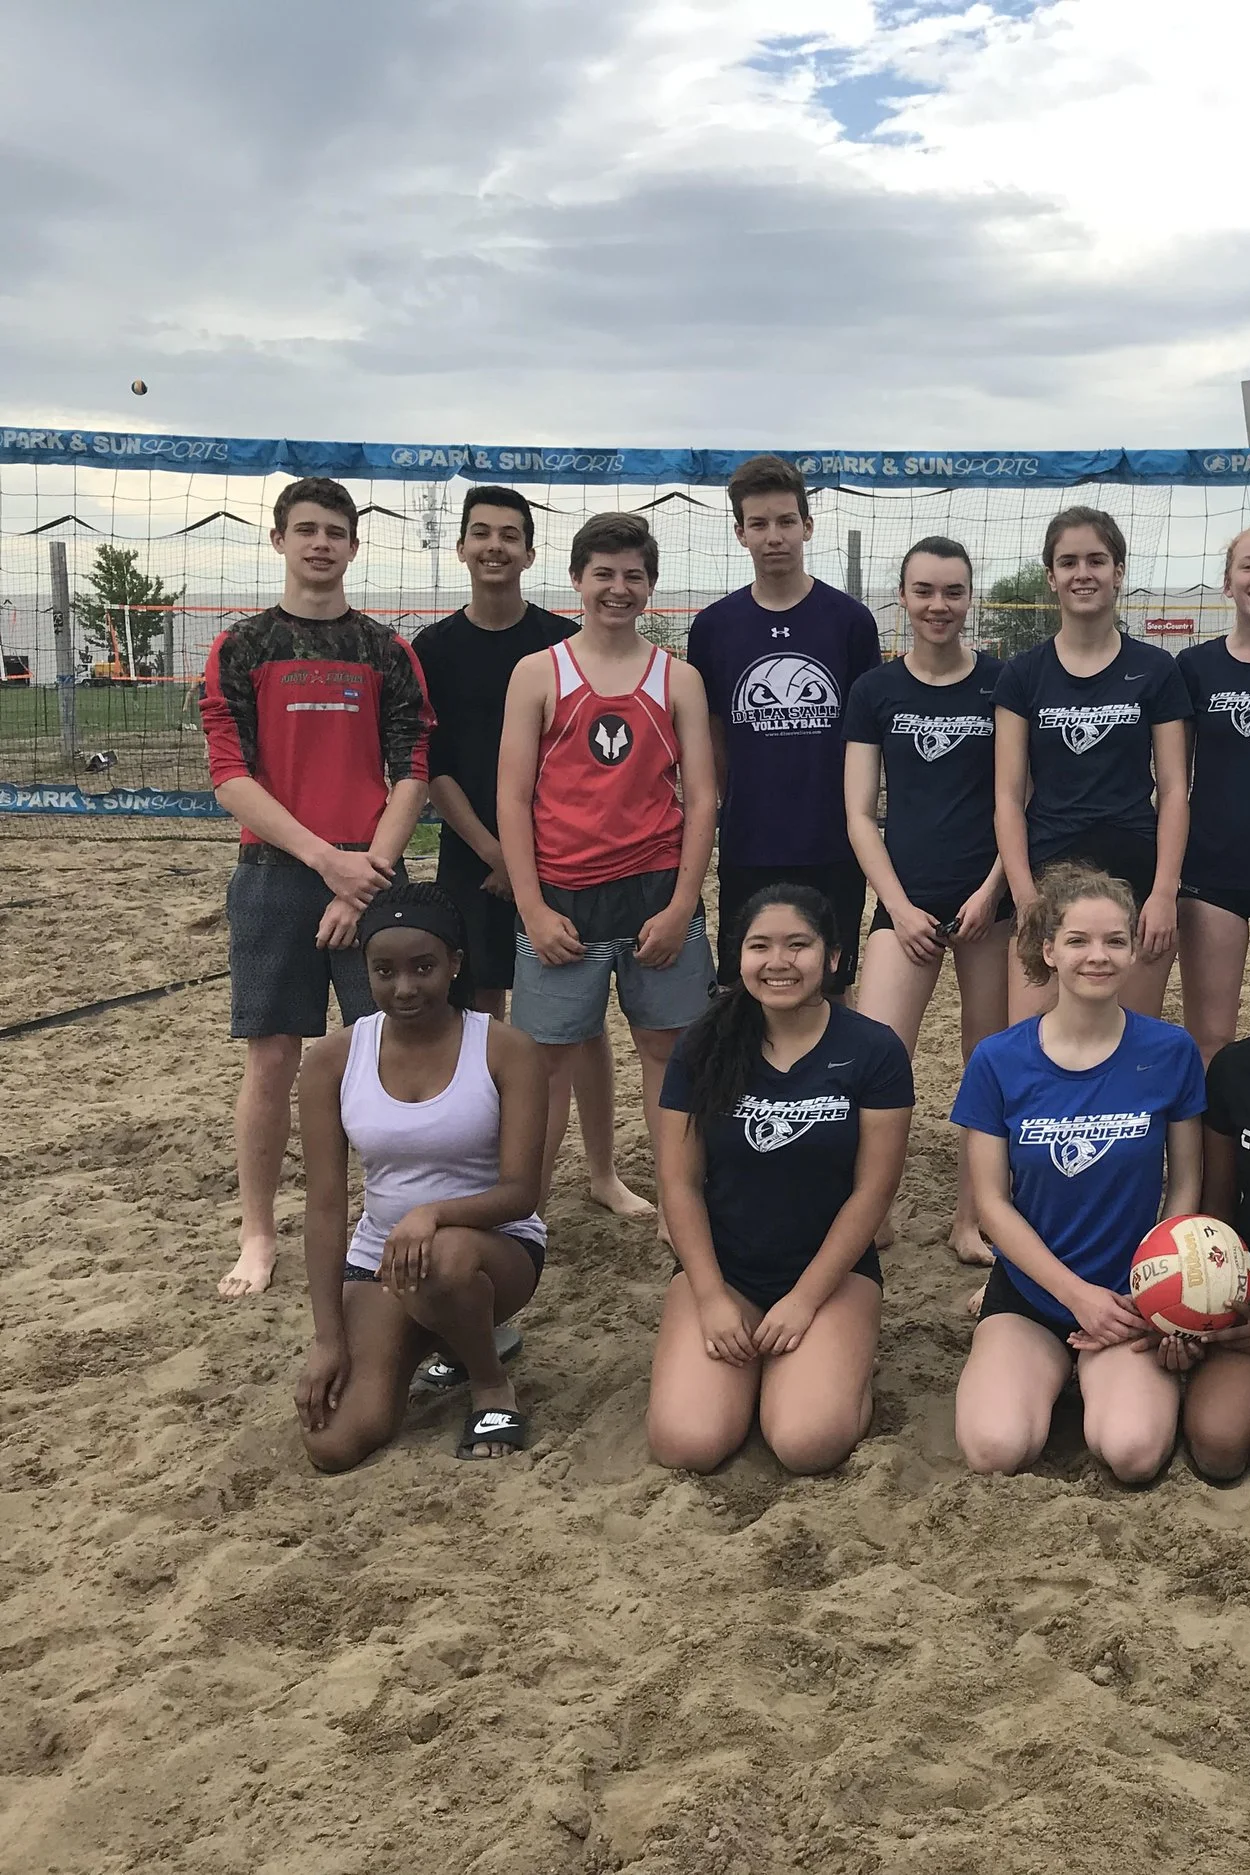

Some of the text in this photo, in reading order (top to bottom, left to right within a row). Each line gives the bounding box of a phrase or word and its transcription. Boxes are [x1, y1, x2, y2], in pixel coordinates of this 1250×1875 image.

[3, 430, 64, 451] PARK
[70, 434, 87, 453] &
[474, 450, 493, 469] &
[821, 456, 876, 476] PARK
[882, 456, 899, 476] &
[731, 709, 756, 724] DE
[760, 707, 785, 721] LA
[1039, 703, 1141, 715] VOLLEYBALL
[752, 718, 832, 732] VOLLEYBALL
[893, 713, 993, 723] VOLLEYBALL
[1039, 712, 1141, 728] CAVALIERS
[892, 719, 994, 736] CAVALIERS
[17, 791, 78, 808] PARK
[738, 1106, 848, 1120] AVALIERS
[1021, 1111, 1151, 1126] VOLLEYBALL
[1020, 1124, 1149, 1144] CAVALIERS
[1142, 1258, 1169, 1282] DLS
[481, 1412, 512, 1425] NIKE
